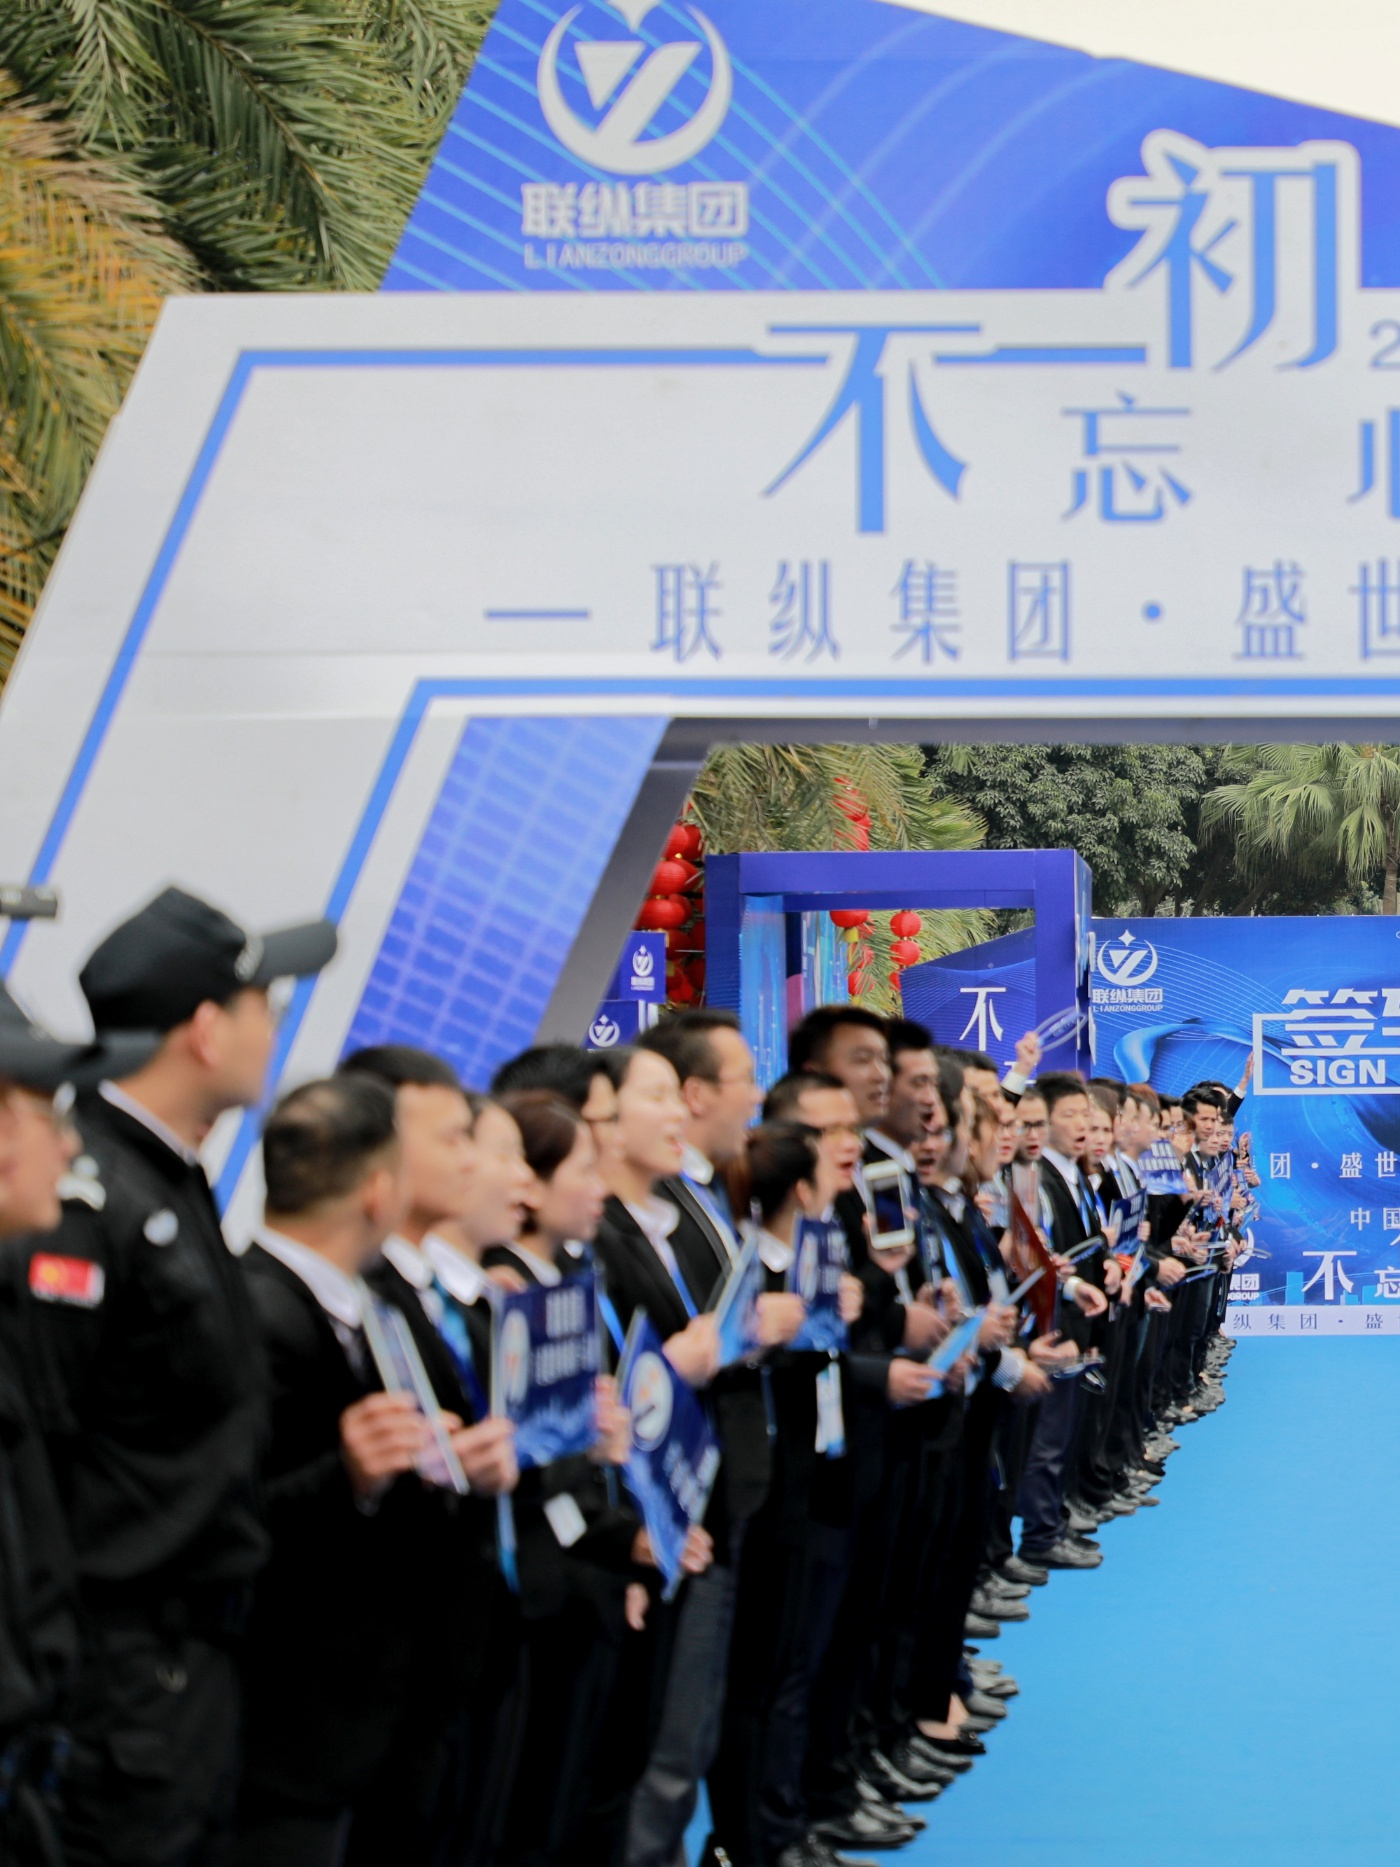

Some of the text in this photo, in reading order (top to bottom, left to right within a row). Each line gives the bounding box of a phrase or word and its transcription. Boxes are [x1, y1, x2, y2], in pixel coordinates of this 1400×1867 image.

[521, 181, 749, 238] 联纵集团
[524, 242, 749, 269] LIANZONGGROUP
[1092, 987, 1163, 1004] 联纵集团
[1093, 1004, 1163, 1013] LIANZONGGROUP
[958, 986, 1007, 1052] 不
[1289, 1058, 1386, 1086] SIGN
